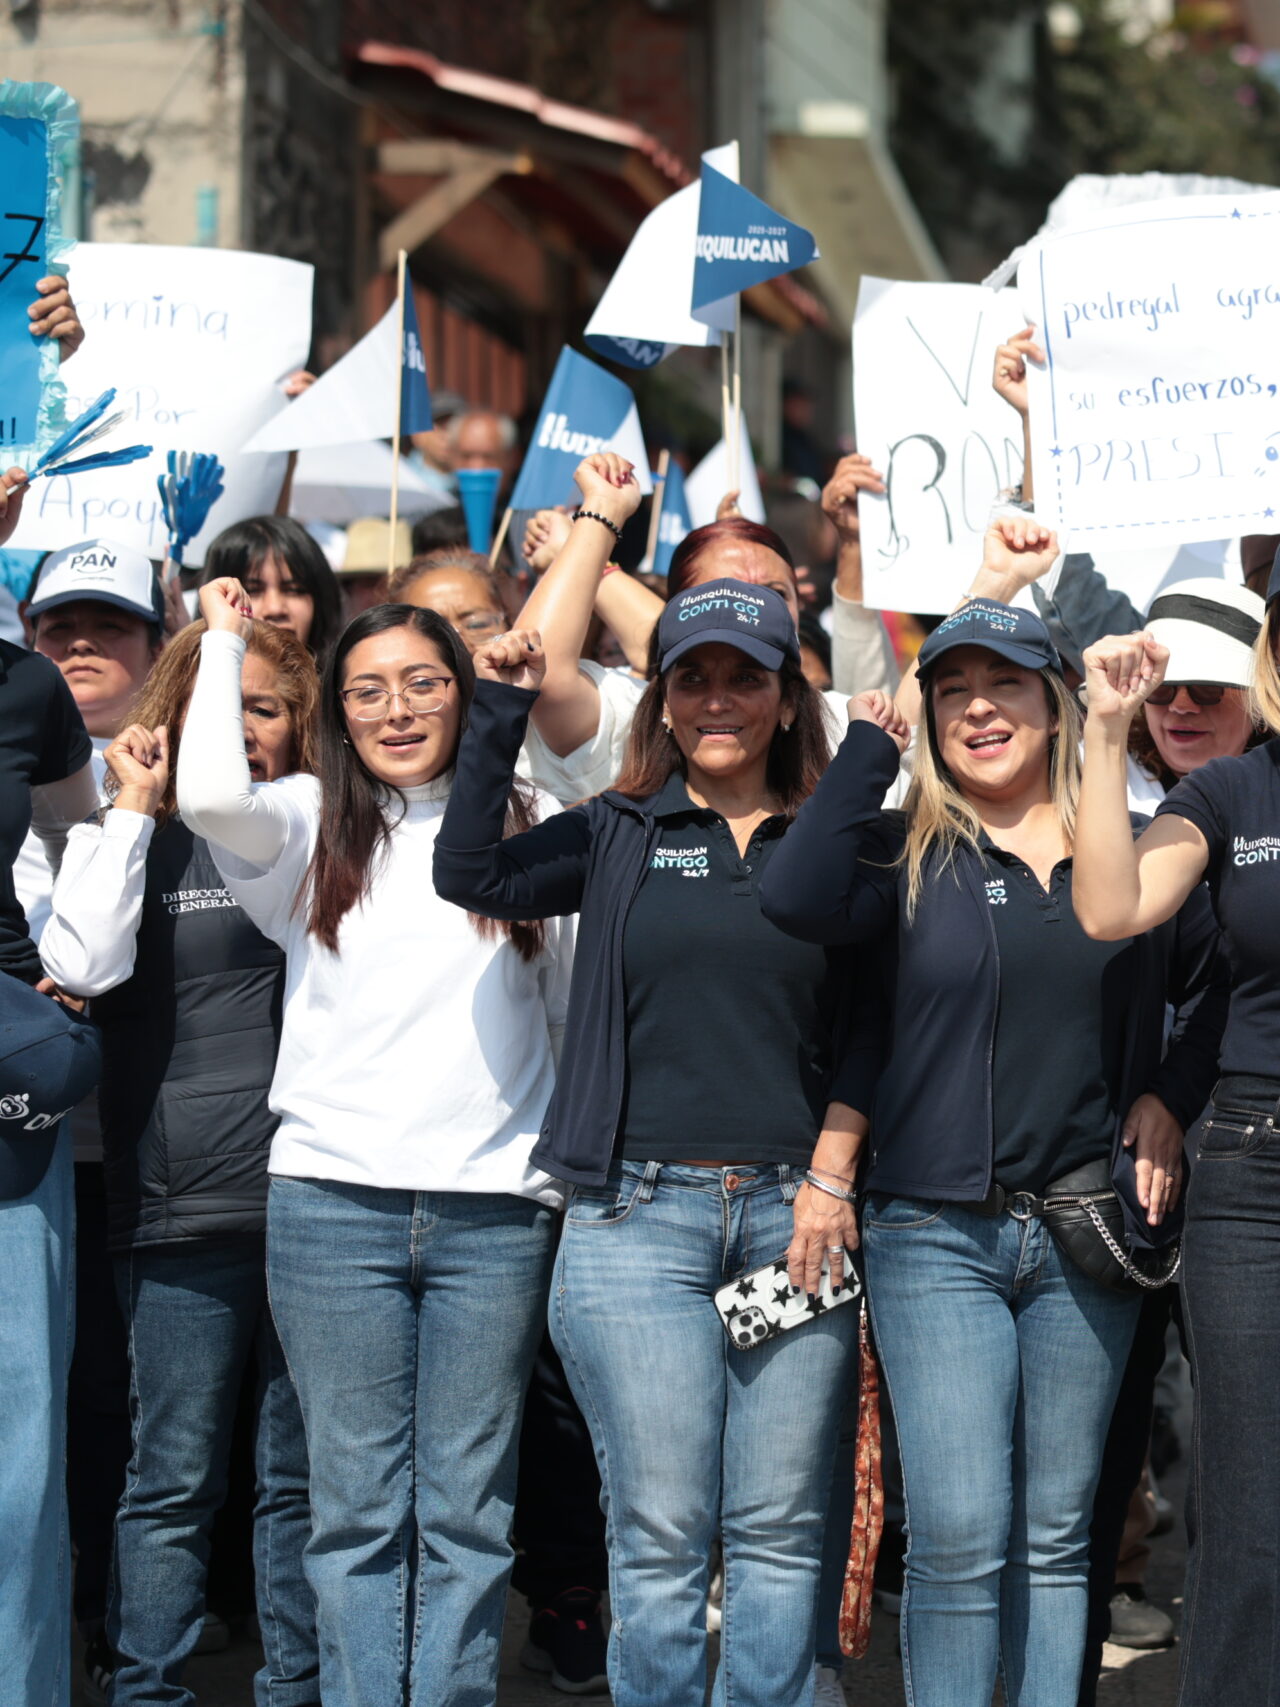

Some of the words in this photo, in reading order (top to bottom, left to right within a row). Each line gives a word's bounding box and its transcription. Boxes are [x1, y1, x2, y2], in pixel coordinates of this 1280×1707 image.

[75, 295, 229, 341] omina
[1064, 283, 1181, 338] pedregal
[1118, 373, 1278, 406] esfuerzos,
[39, 474, 165, 546] Apoy
[70, 553, 117, 569] PAN
[736, 612, 761, 627] 24/7
[938, 610, 1017, 635] CONTIGO
[990, 622, 1017, 634] 24/7
[656, 846, 708, 857] QUILUCAN
[650, 855, 709, 869] NTIGO
[682, 869, 710, 877] 24/7
